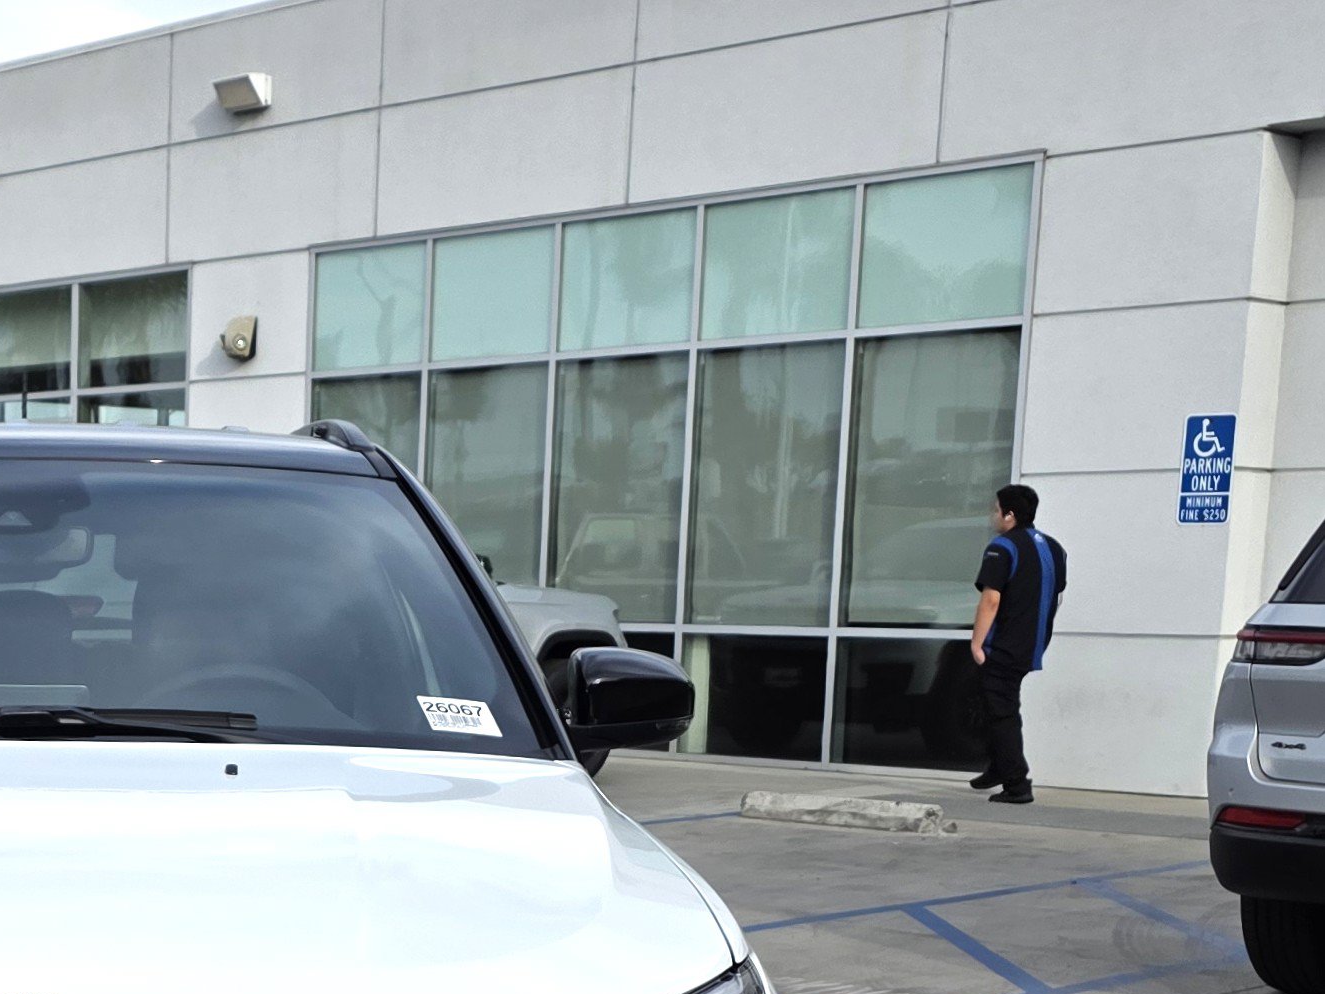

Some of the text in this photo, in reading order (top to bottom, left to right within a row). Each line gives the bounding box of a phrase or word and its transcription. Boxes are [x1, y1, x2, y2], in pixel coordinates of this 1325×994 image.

[1183, 457, 1231, 474] PARKING
[1191, 475, 1221, 491] ONLY
[1186, 496, 1222, 508] MINIMUM
[1180, 509, 1226, 521] FINE $250
[423, 701, 482, 717] 26067
